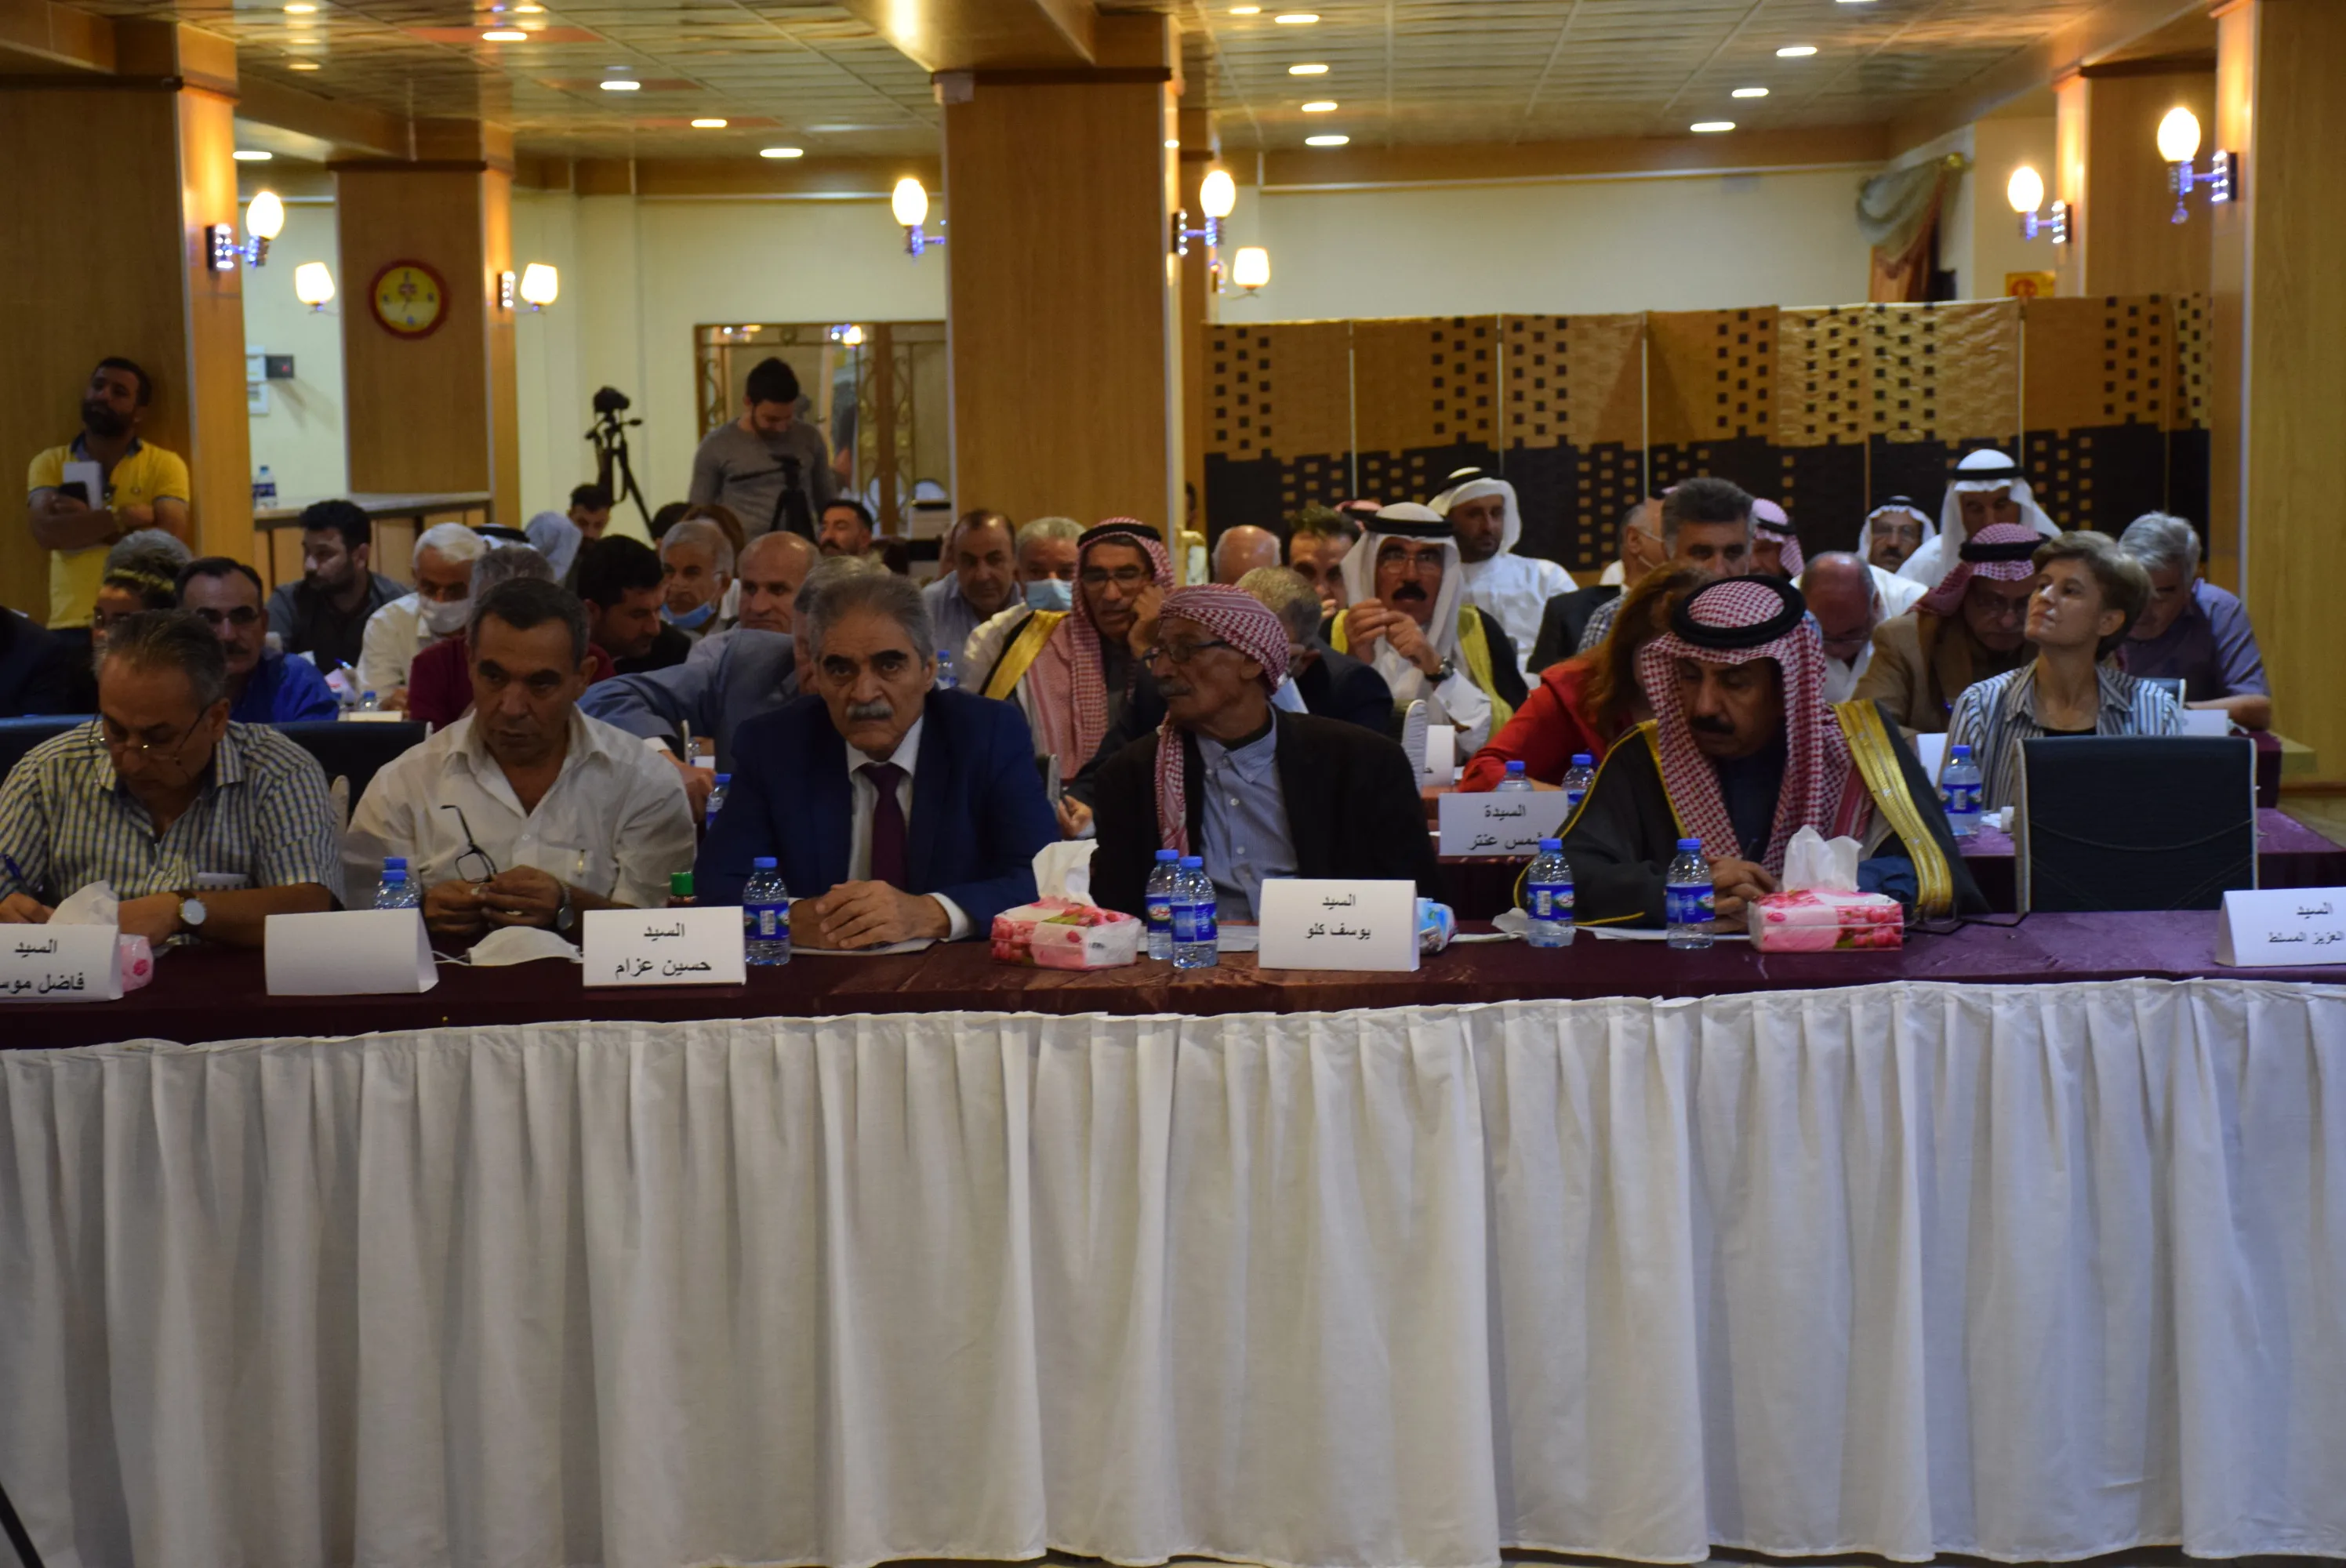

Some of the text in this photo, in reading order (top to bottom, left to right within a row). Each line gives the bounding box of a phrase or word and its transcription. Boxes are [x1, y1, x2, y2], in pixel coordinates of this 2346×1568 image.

[1484, 804, 1527, 821] السيدة
[1467, 834, 1498, 851] عنتر
[1321, 893, 1356, 910] السيد
[2296, 902, 2331, 919] السيد
[643, 922, 685, 942] السيد
[1305, 923, 1371, 940] يوسف كلو
[15, 938, 58, 958] السيد
[615, 957, 711, 980] حسين عزام
[0, 971, 85, 995] فاضل موس
